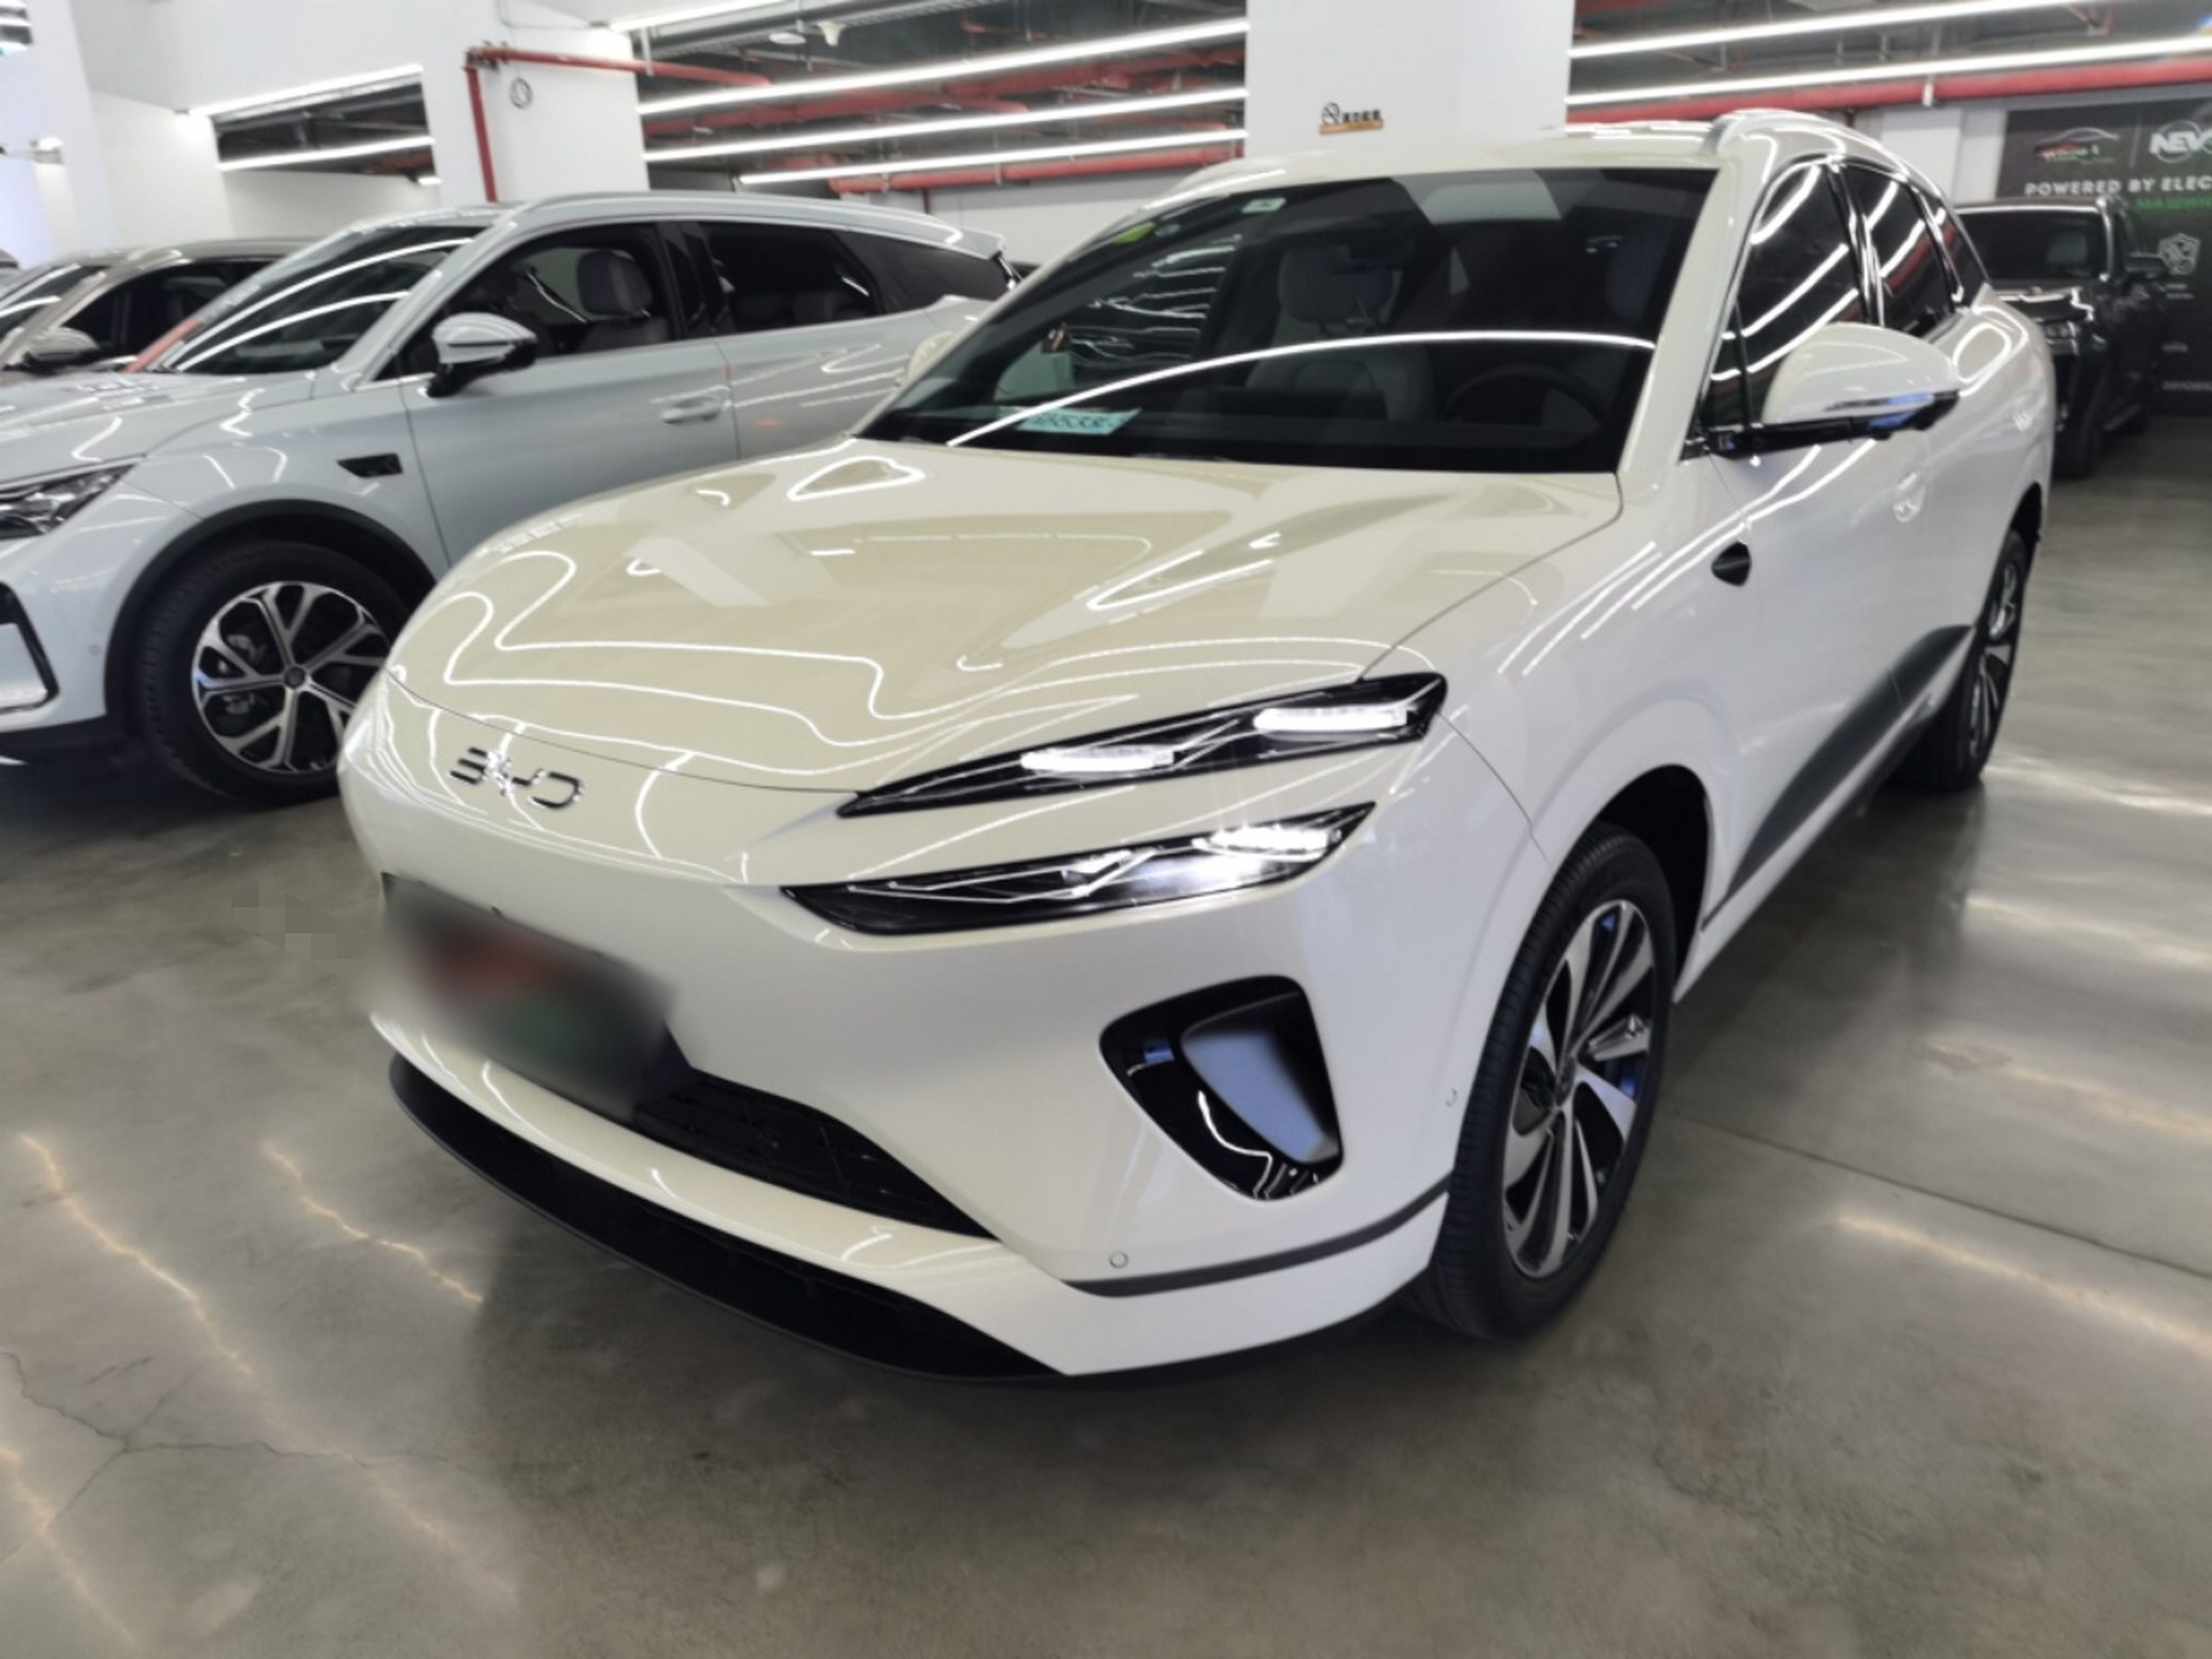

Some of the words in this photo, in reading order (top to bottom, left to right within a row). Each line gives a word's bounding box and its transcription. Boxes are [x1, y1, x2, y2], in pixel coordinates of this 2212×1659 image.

[2024, 179, 2122, 196] POWERED
[2127, 177, 2156, 194] BY
[2161, 175, 2212, 192] ELEC
